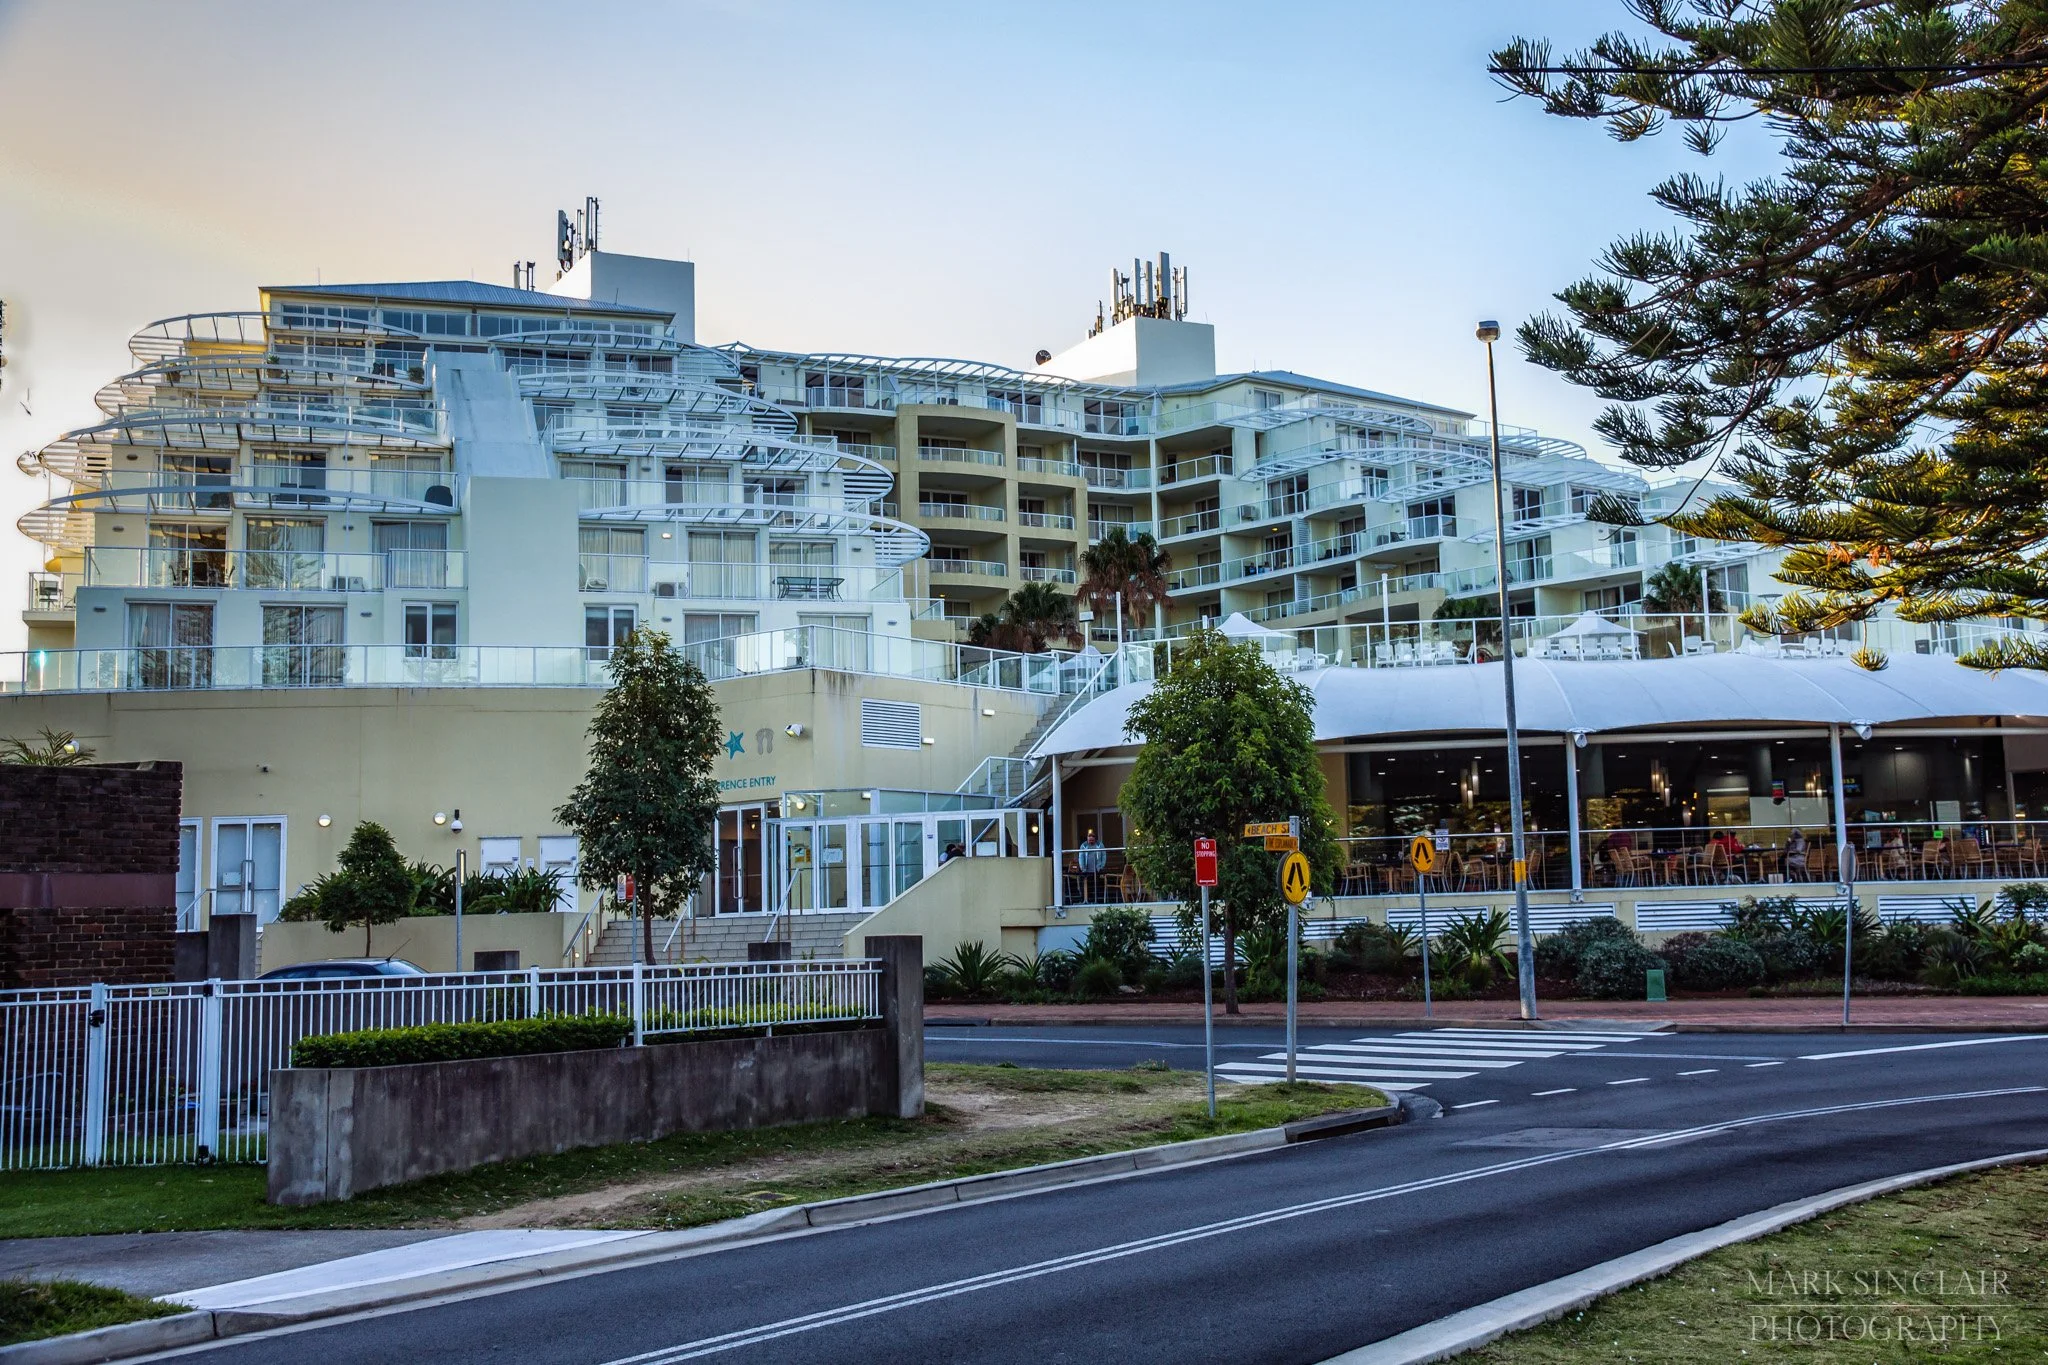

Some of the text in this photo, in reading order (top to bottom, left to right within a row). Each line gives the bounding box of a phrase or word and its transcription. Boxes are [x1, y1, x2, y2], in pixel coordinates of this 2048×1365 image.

[750, 776, 776, 787] ENTRY
[1251, 824, 1277, 835] BEACH
[1196, 850, 1216, 858] STOPPING
